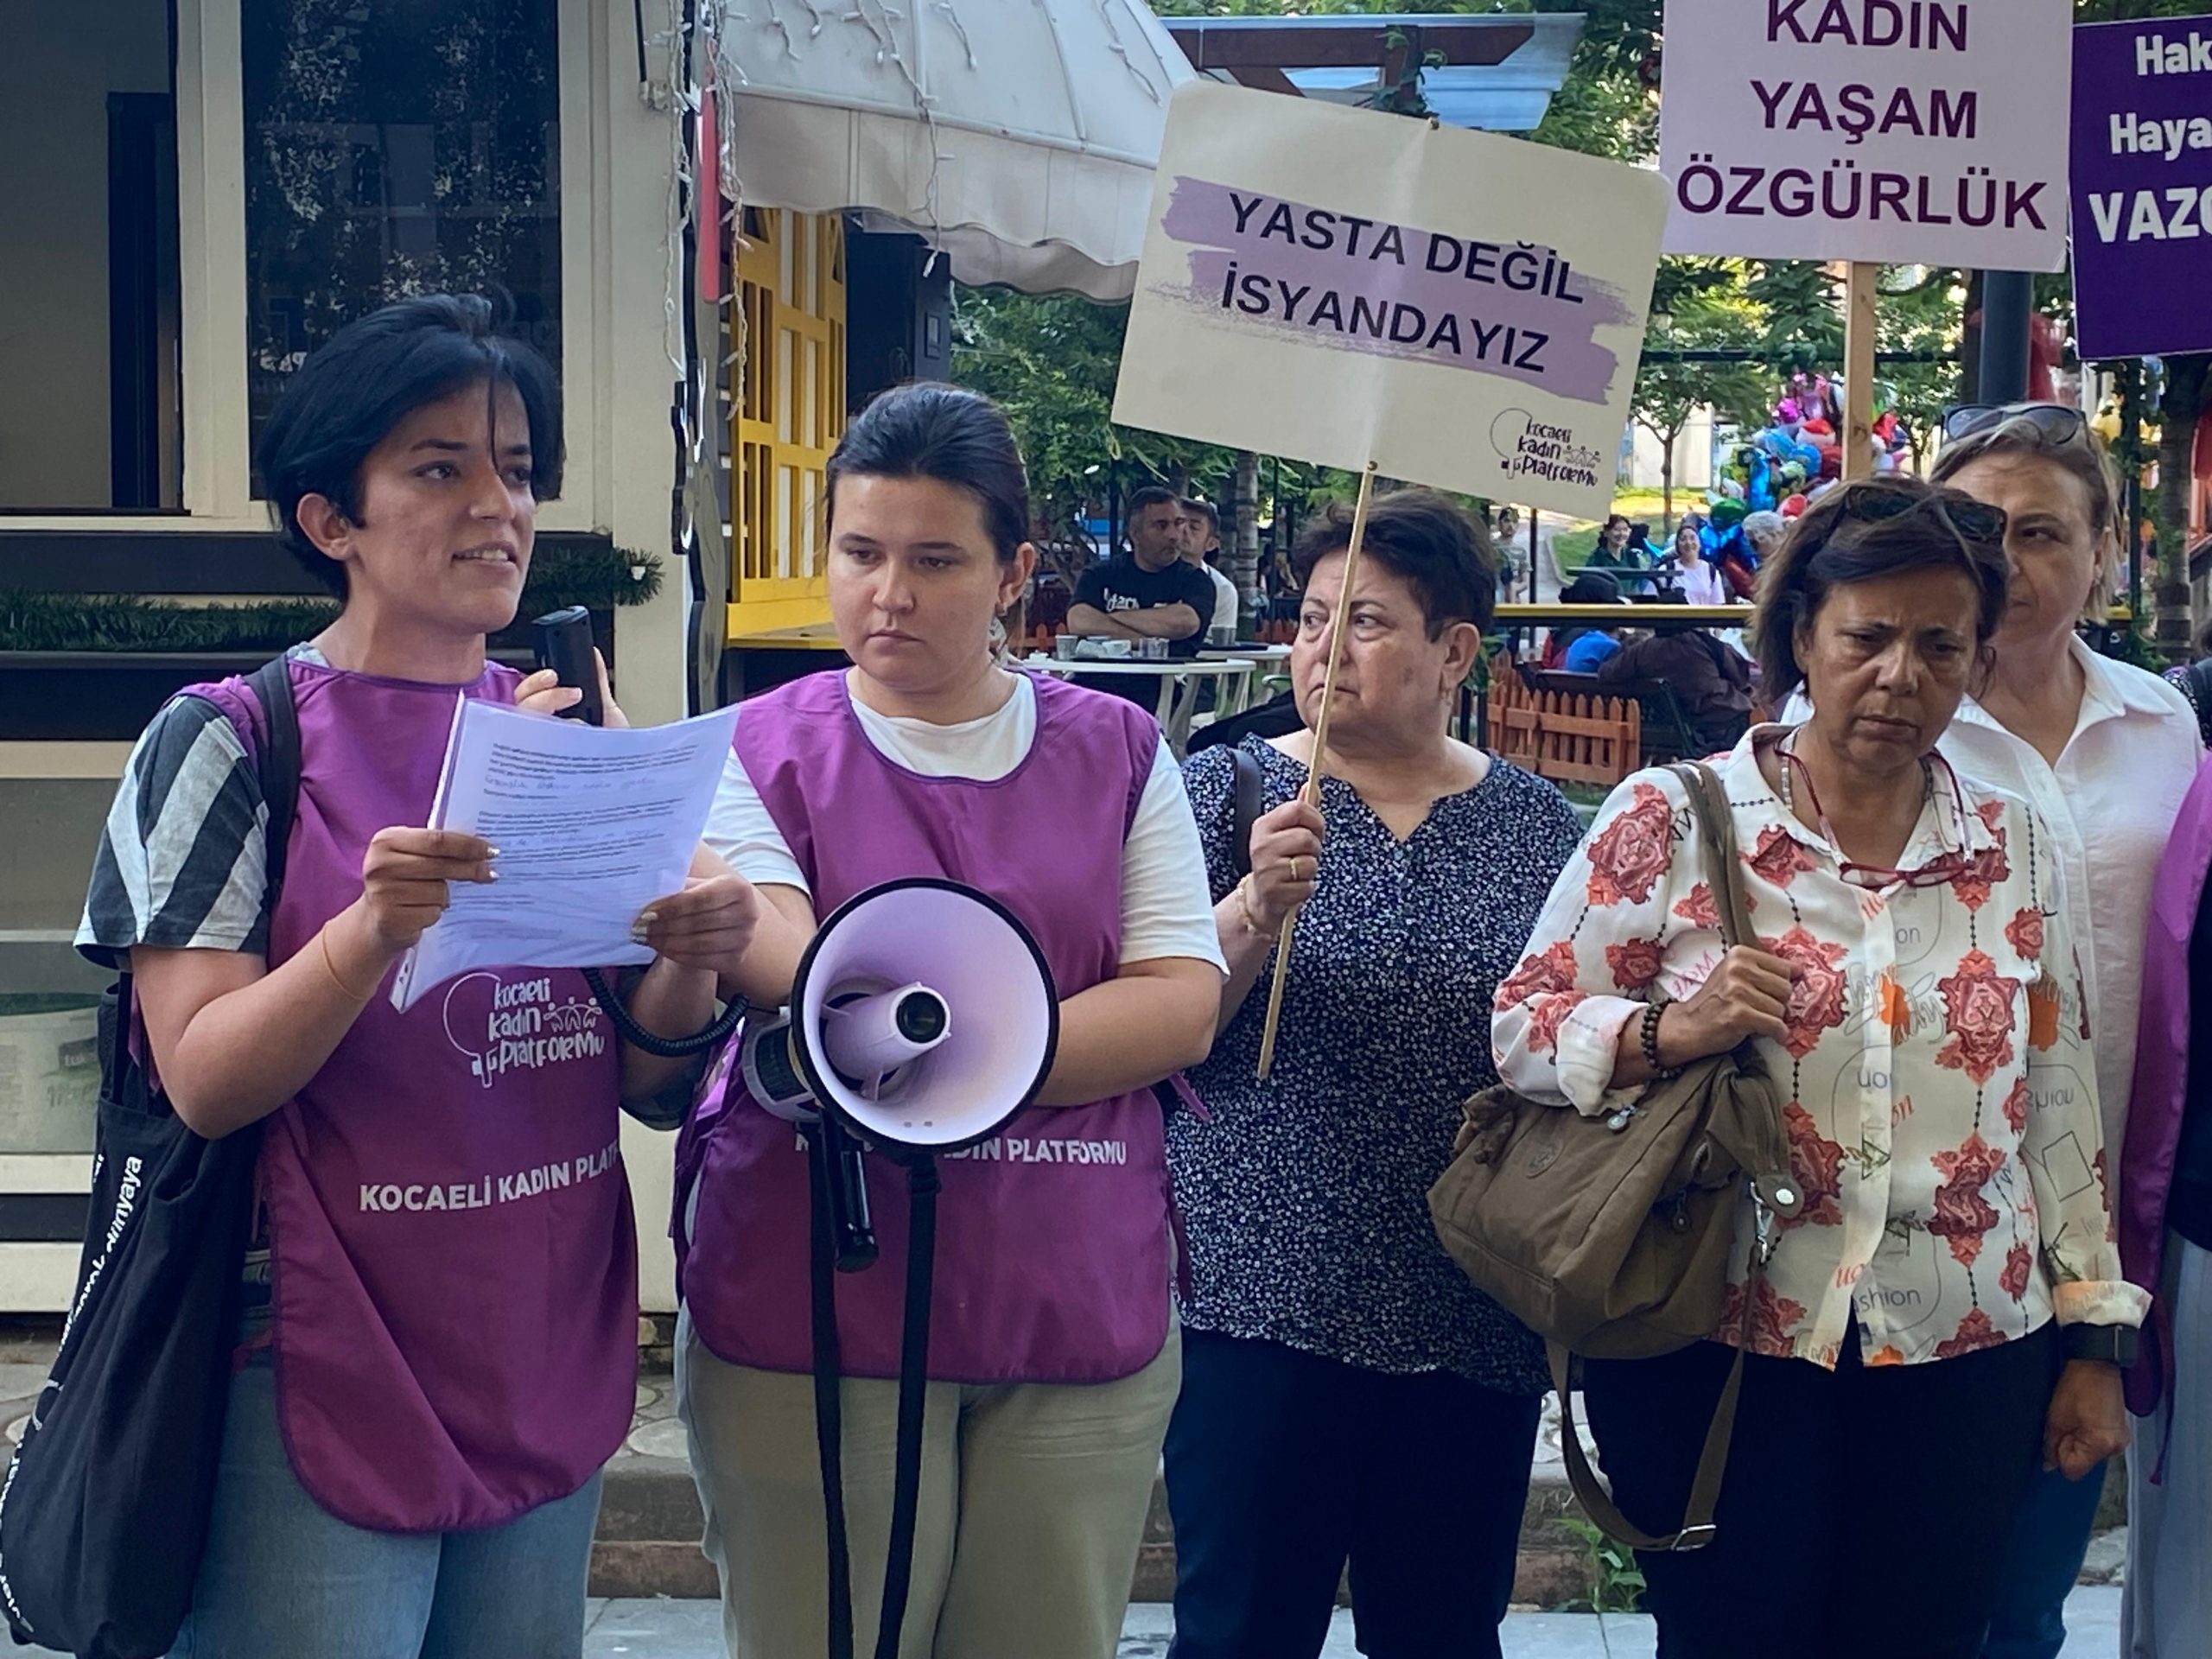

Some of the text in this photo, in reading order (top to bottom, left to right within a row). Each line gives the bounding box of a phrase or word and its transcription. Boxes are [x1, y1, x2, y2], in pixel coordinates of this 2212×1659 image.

[1767, 0, 1967, 52] KADIN
[1751, 79, 1977, 144] YAŞAM
[1677, 154, 2048, 231] ÖZGÜRLÜK
[1229, 192, 1586, 304] YASTA DEĞİL
[1221, 262, 1550, 373] İSYANDAYIZ
[1007, 1138, 1127, 1166] PLATFORMU
[359, 1174, 492, 1211] KOCAELİ
[498, 1161, 570, 1203] KADIN
